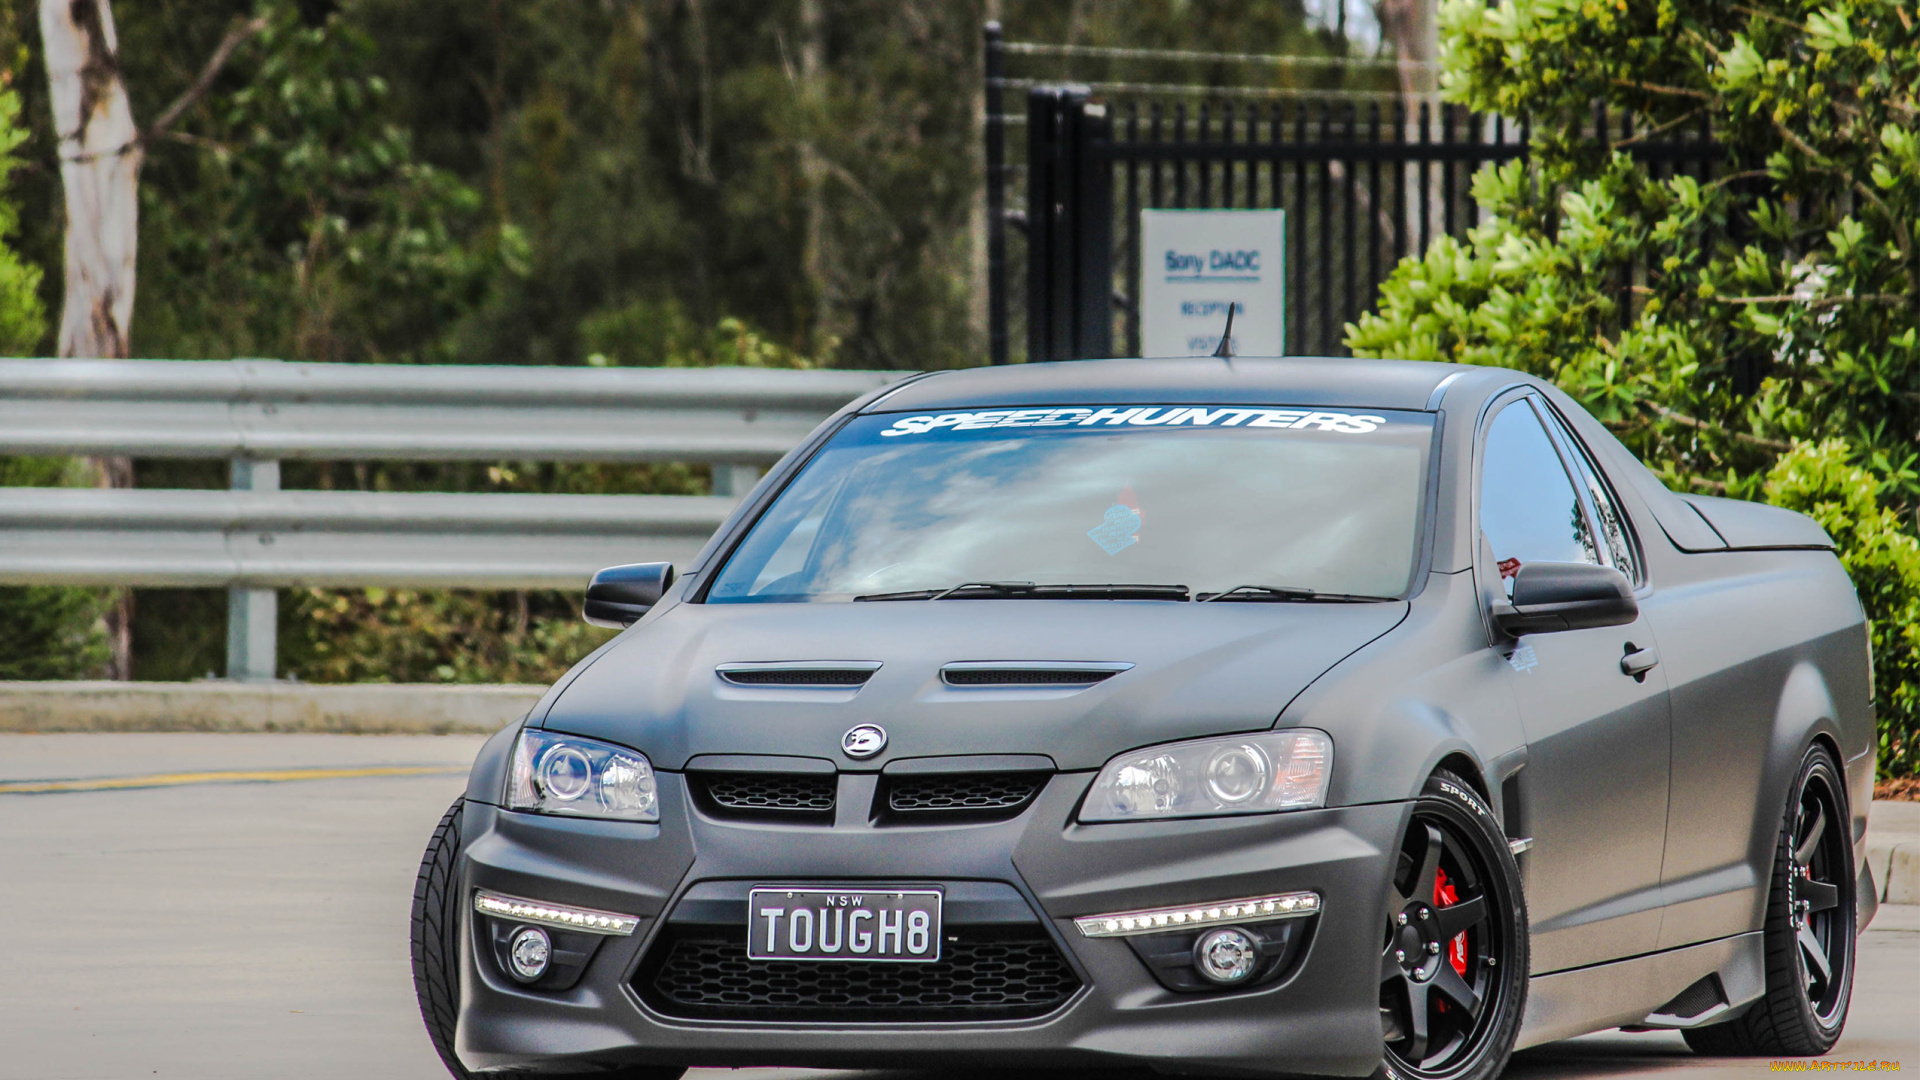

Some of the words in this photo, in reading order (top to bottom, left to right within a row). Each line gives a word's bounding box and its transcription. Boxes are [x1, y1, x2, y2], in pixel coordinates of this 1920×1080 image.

[1165, 250, 1203, 273] Sony
[1210, 250, 1260, 271] DADC
[1181, 302, 1244, 315] RECEPTIN
[880, 408, 1386, 436] SPEEDHUNTERS
[1440, 782, 1485, 815] SPORT
[826, 896, 863, 906] NSW
[761, 908, 930, 954] TOUGH8
